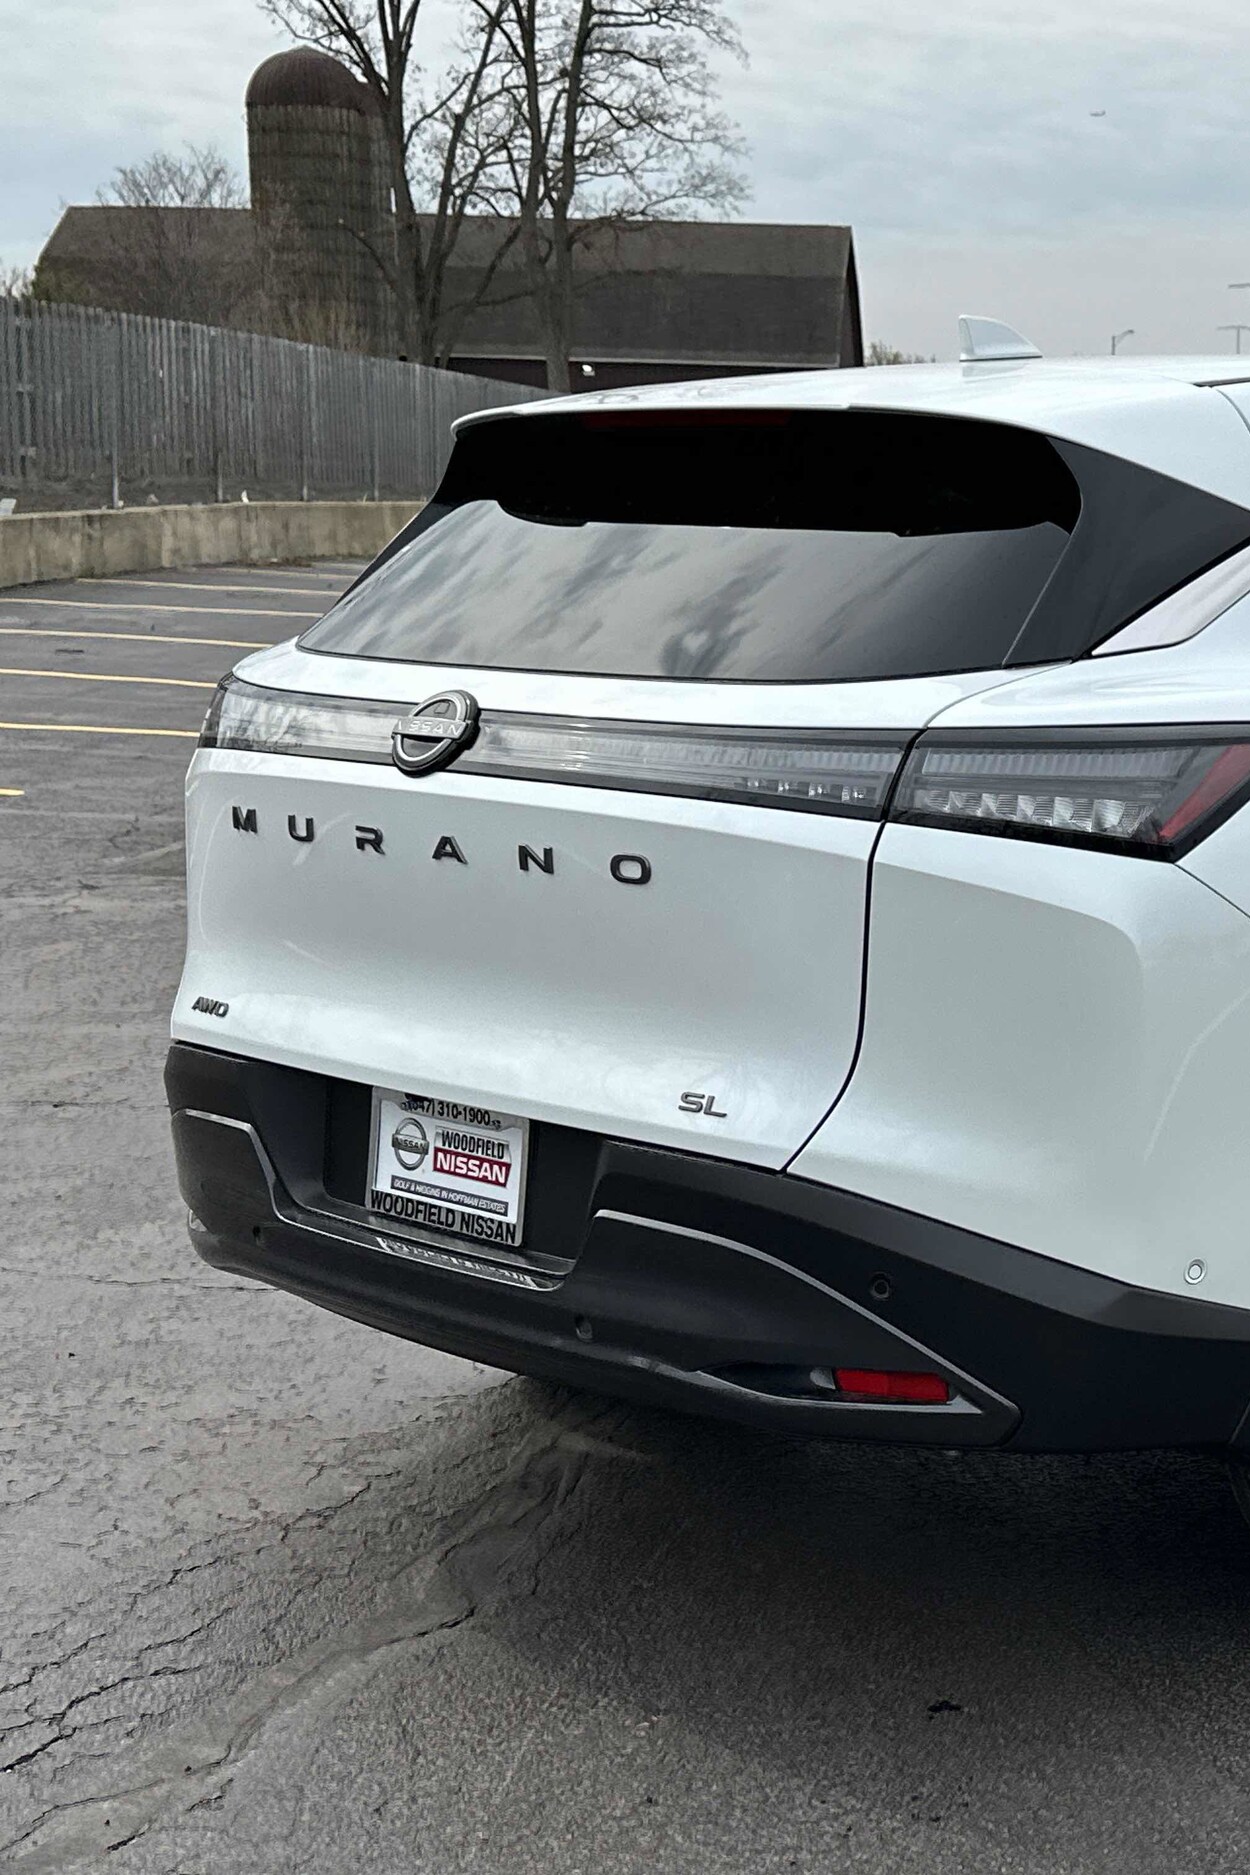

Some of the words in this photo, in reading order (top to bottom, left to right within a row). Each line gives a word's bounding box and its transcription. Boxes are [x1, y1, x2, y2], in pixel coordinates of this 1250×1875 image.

[232, 805, 652, 885] MURANO
[191, 996, 229, 1018] AWD
[678, 1091, 727, 1118] SL
[441, 1130, 505, 1160] WOODFIELD
[436, 1152, 507, 1184] NISSAN
[394, 1178, 410, 1190] GOLF
[371, 1189, 456, 1229] WOODFIELD
[460, 1212, 517, 1245] NISSAN
